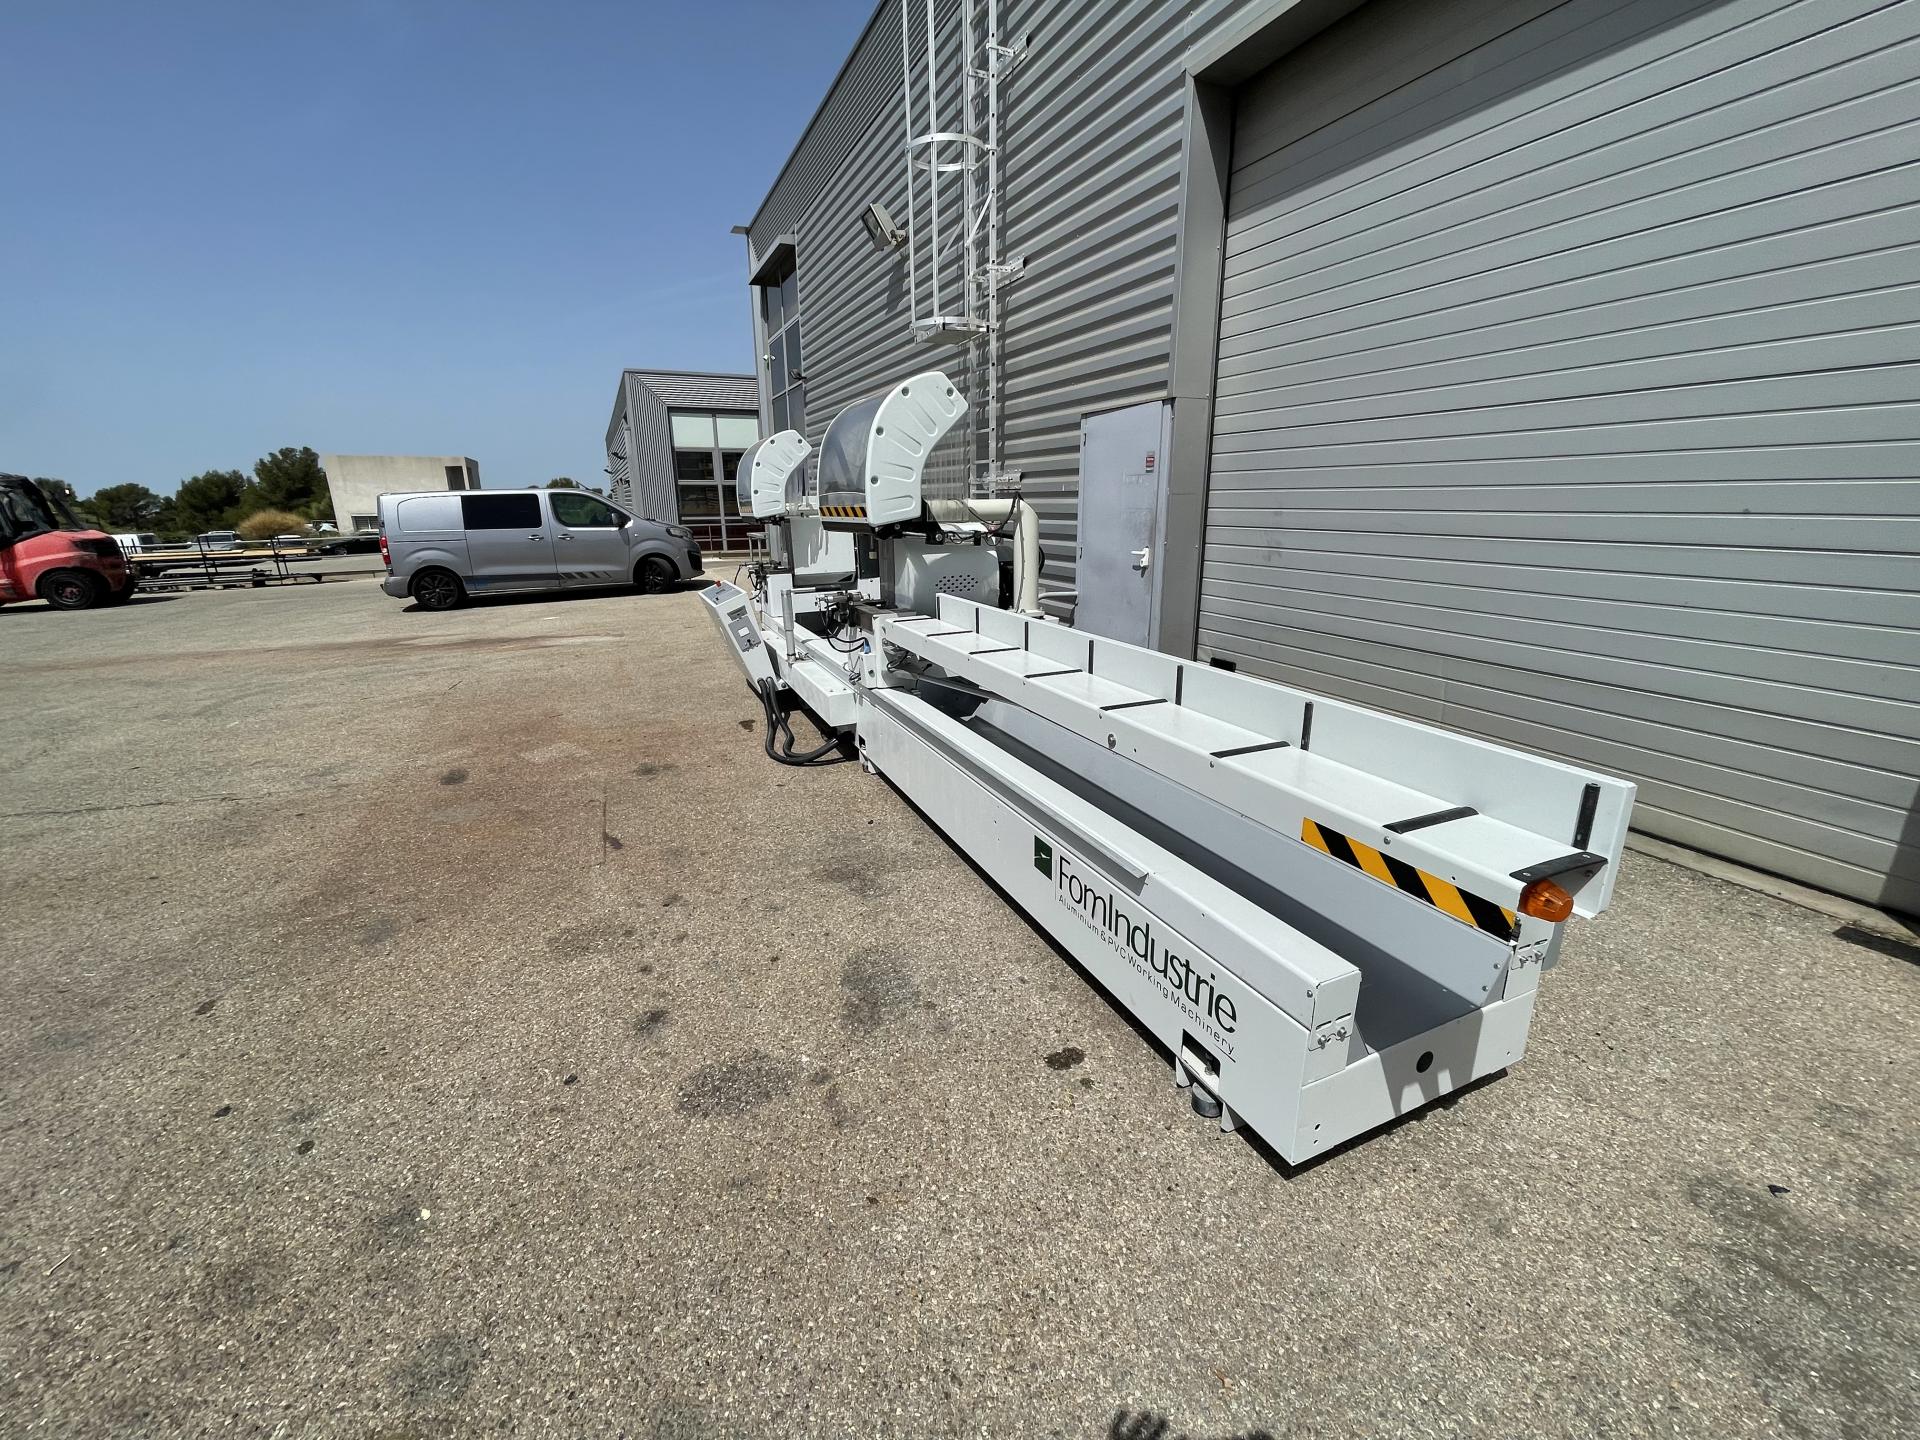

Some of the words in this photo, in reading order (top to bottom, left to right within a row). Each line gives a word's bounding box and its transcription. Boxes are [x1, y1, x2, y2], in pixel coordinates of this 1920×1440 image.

[1058, 855, 1237, 1034] FomIndustrie
[1058, 894, 1099, 936] Aluminium
[1100, 930, 1107, 943] &
[1108, 936, 1127, 959] PVC
[1127, 952, 1169, 999] Working
[1170, 991, 1235, 1055] Machinery
